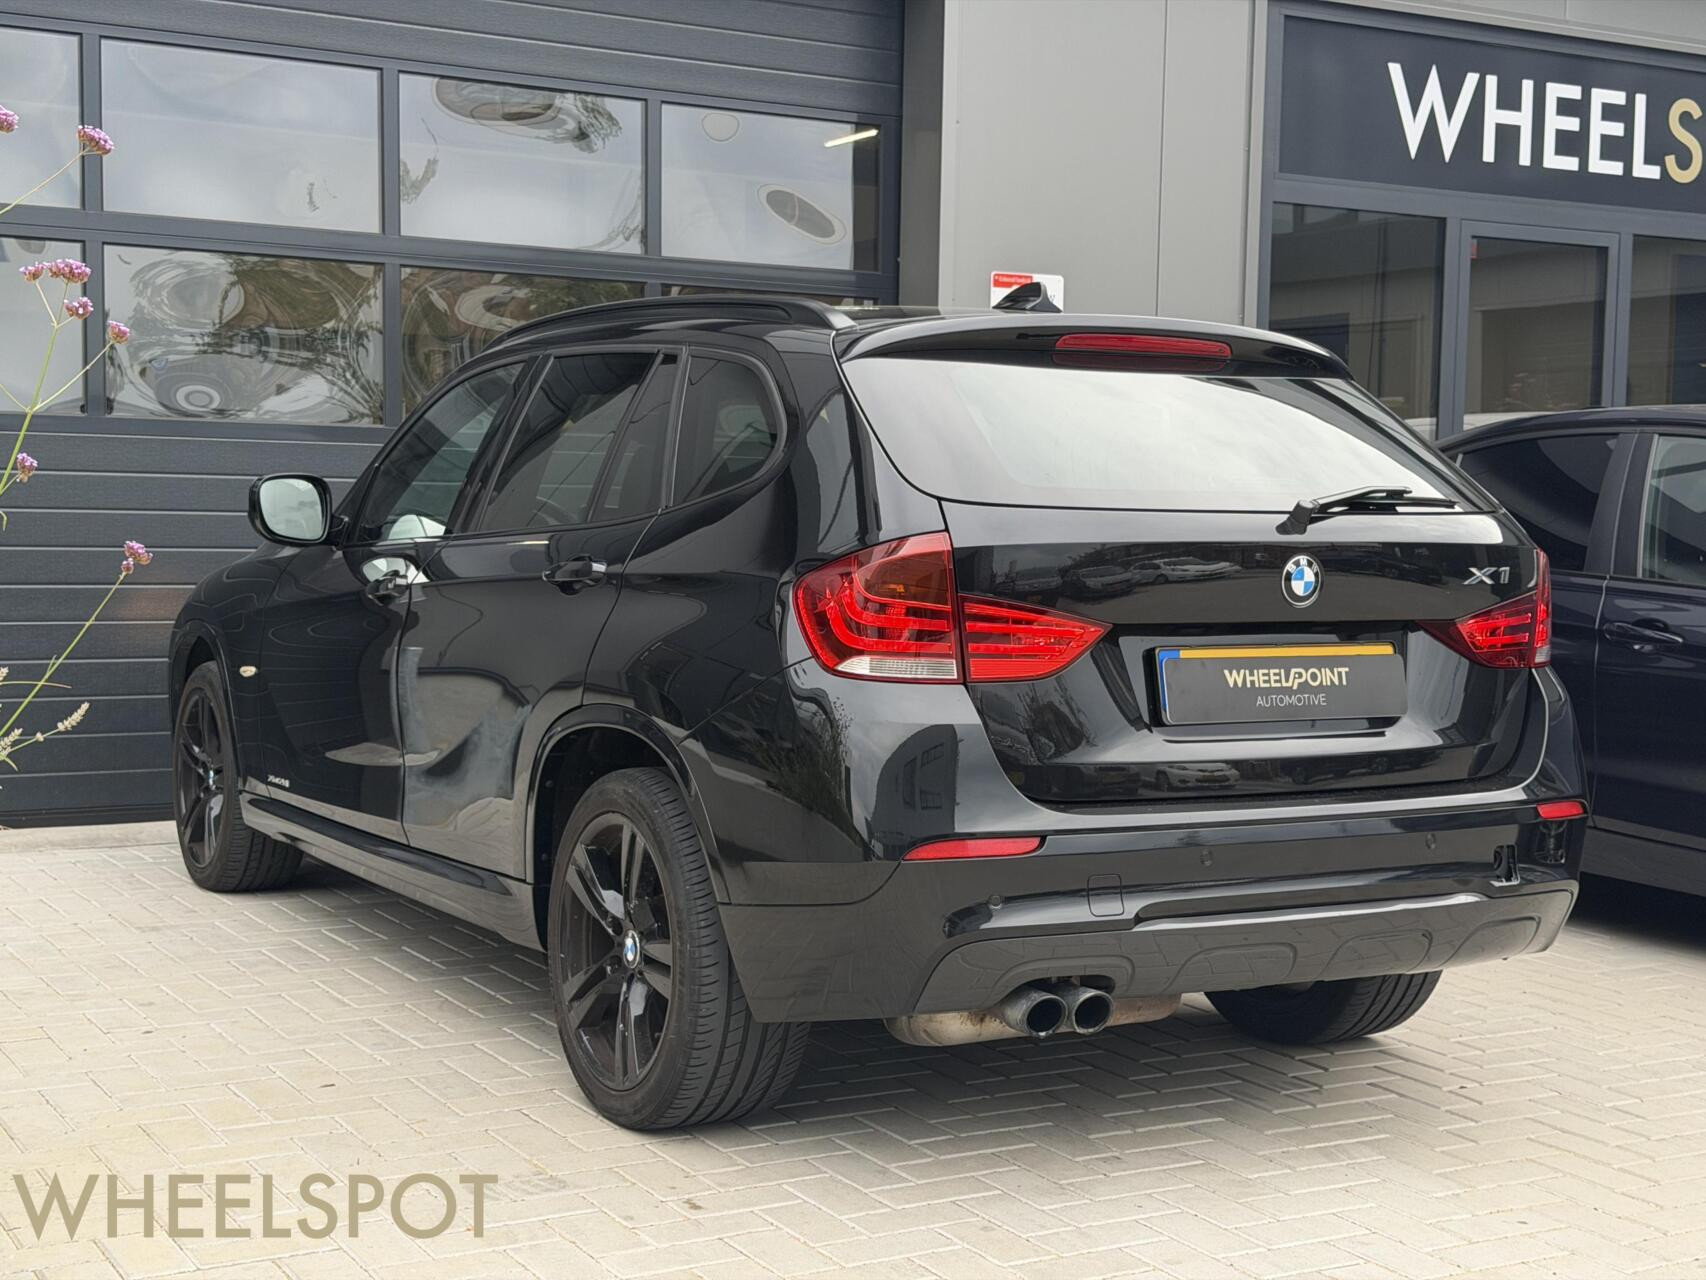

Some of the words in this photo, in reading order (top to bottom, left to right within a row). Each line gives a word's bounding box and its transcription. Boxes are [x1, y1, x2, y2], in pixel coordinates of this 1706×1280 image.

[1387, 62, 1703, 183] WHEELS
[1463, 566, 1510, 585] X1
[1256, 693, 1327, 707] AUTOMOTIVE
